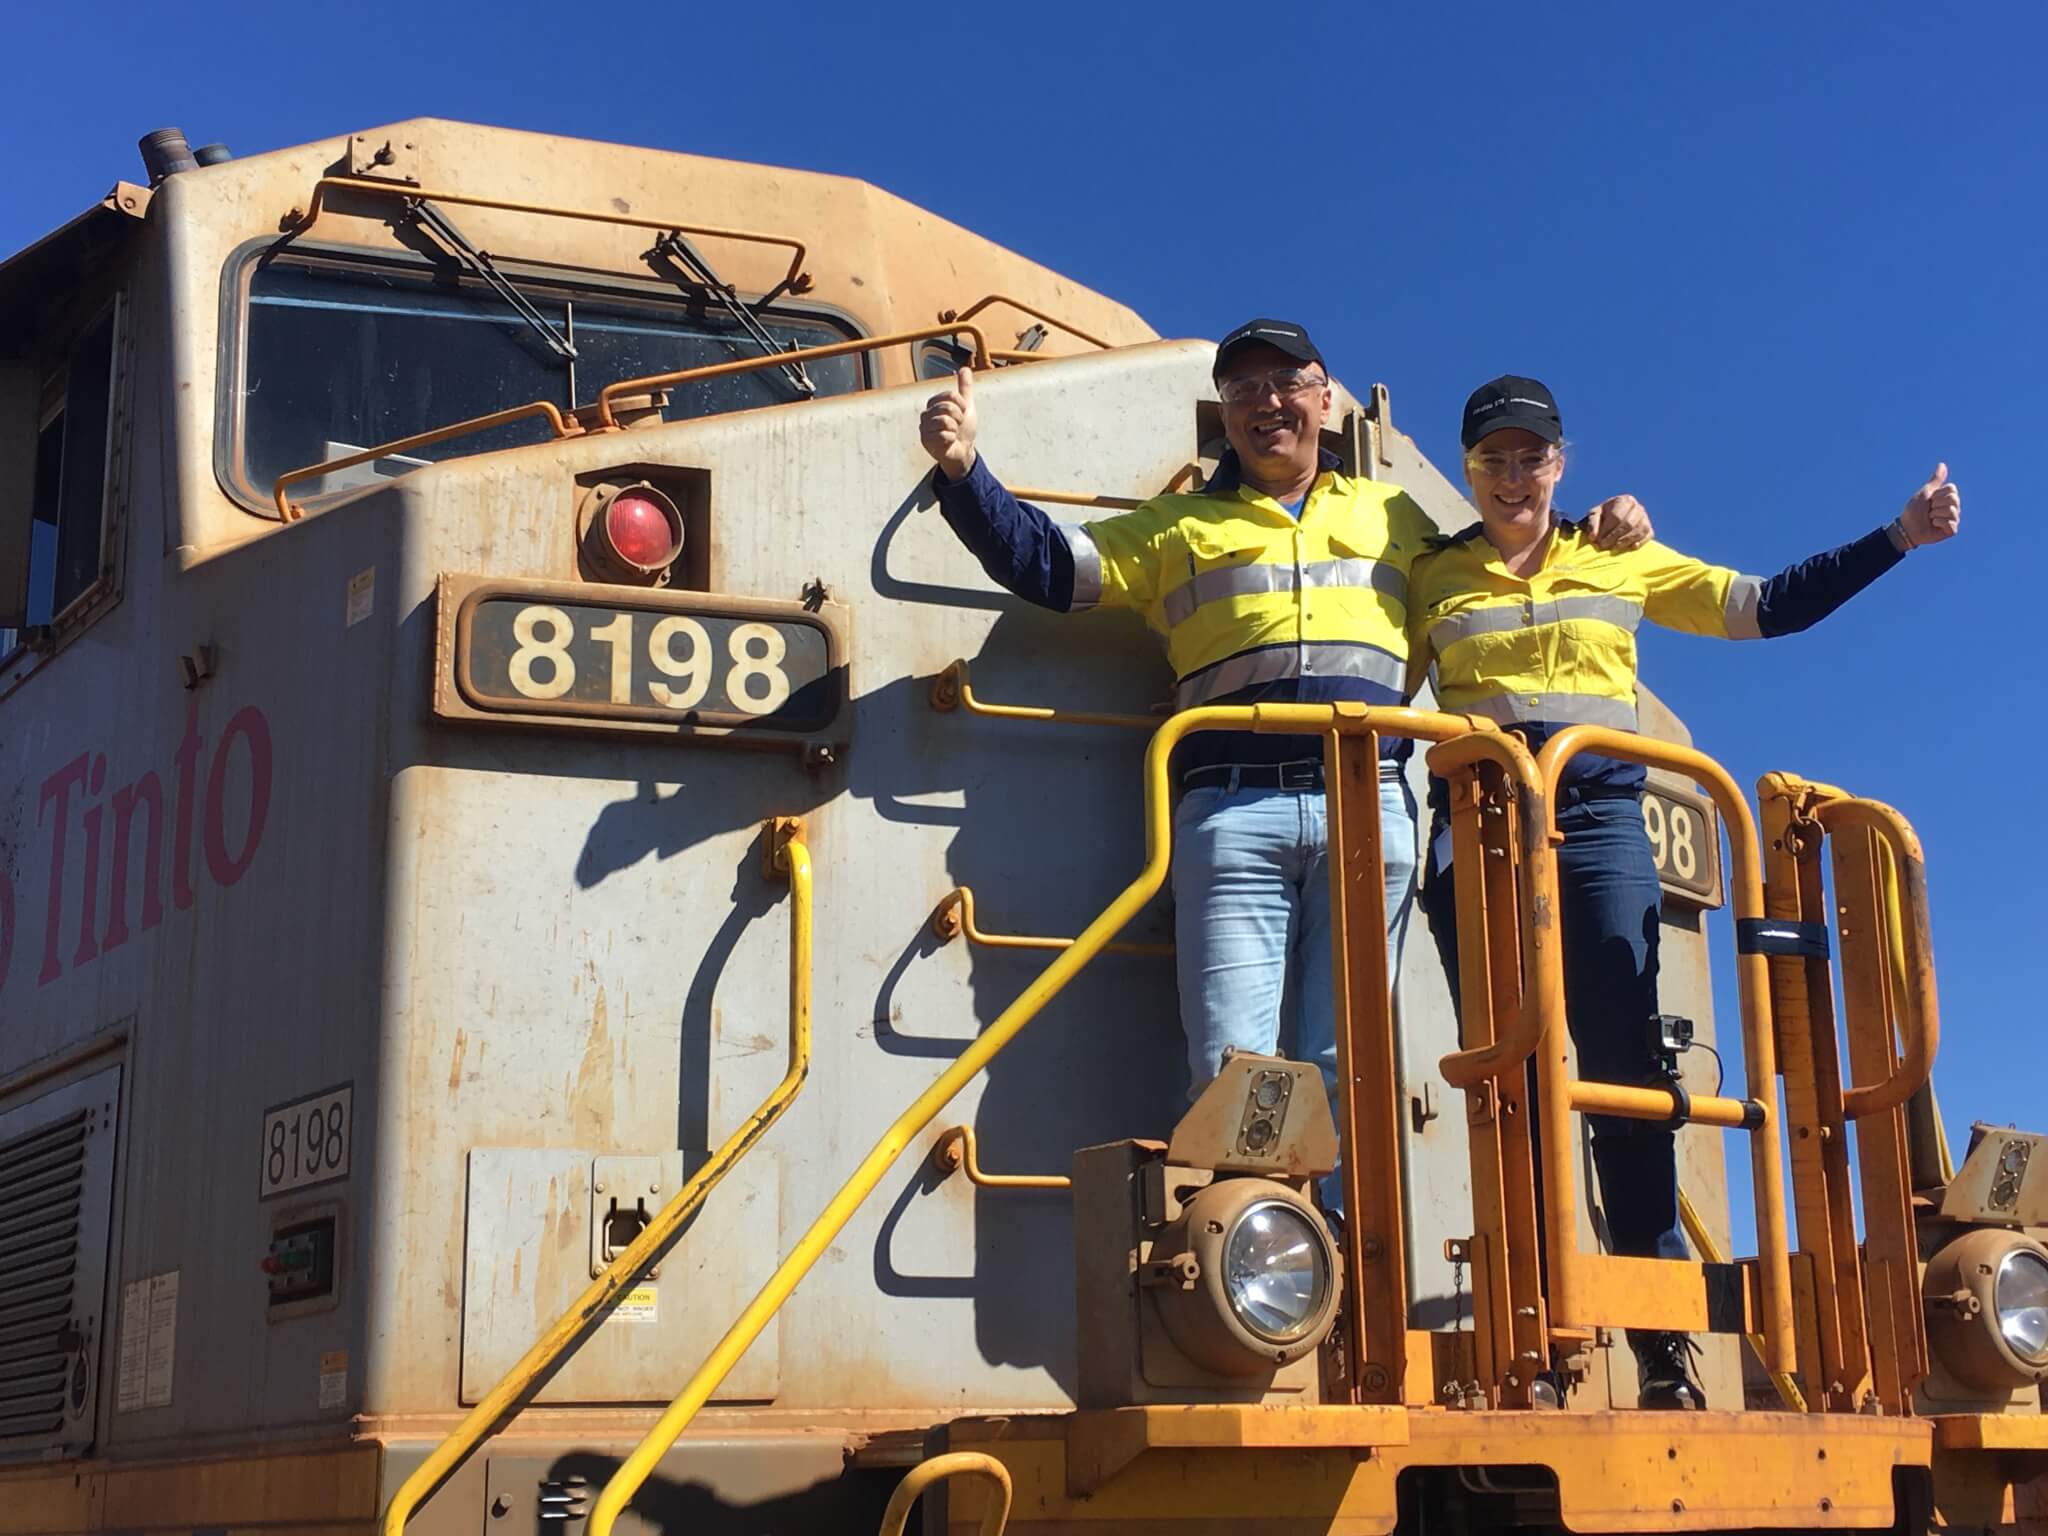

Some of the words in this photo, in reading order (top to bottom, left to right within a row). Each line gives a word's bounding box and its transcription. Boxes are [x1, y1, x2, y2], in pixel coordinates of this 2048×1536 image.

[508, 605, 791, 715] 8198
[37, 701, 273, 989] Tinto
[268, 1102, 343, 1185] 8198
